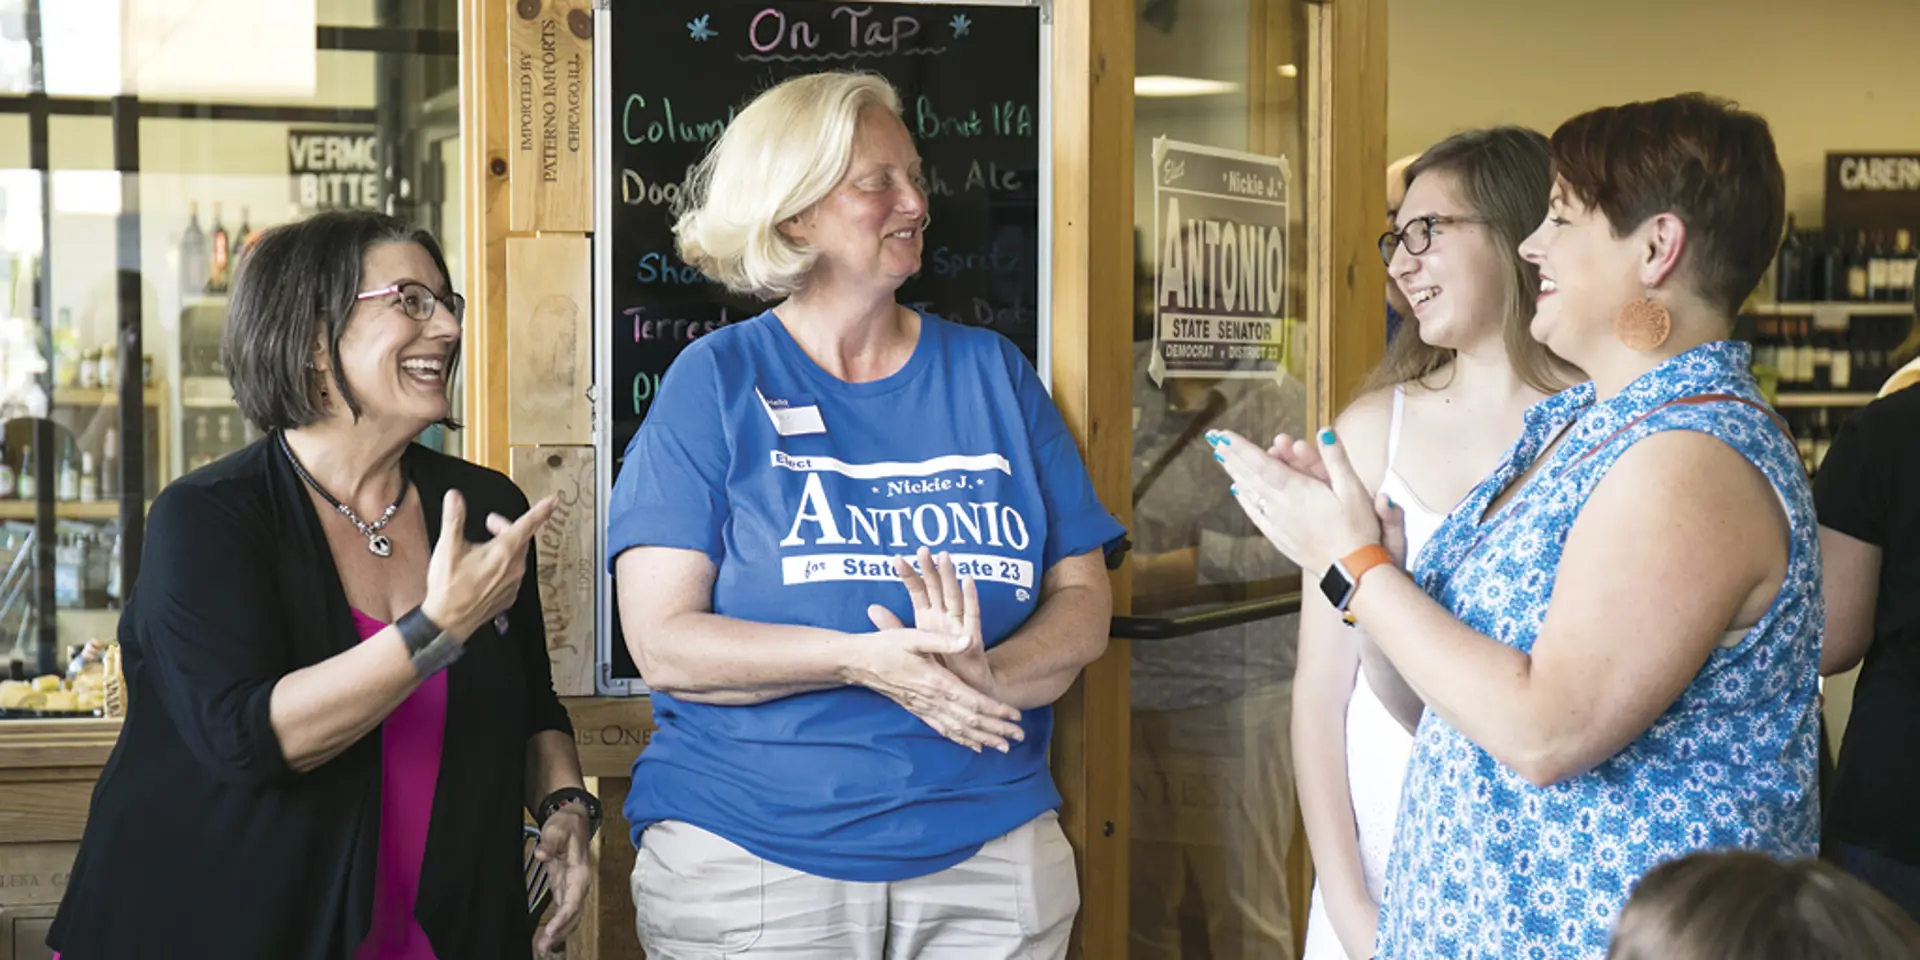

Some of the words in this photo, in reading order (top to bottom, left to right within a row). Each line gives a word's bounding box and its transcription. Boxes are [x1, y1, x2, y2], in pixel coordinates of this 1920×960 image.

[749, 8, 820, 51] On
[831, 5, 920, 51] Tap
[520, 52, 532, 71] BY
[541, 19, 557, 97] IMPORTS
[520, 74, 533, 151] IMPORTED
[542, 101, 557, 182] PATERNO
[1228, 170, 1265, 197] Nickie
[1266, 177, 1279, 198] J.
[1159, 196, 1284, 315] ANTONIO
[1172, 317, 1211, 339] STATE
[1217, 319, 1272, 341] SENATOR
[1165, 343, 1215, 358] DEMOCRAT
[775, 453, 813, 469] Elect
[886, 478, 952, 498] Nickie
[955, 475, 974, 490] J.
[804, 560, 826, 579] for
[999, 560, 1021, 581] 23
